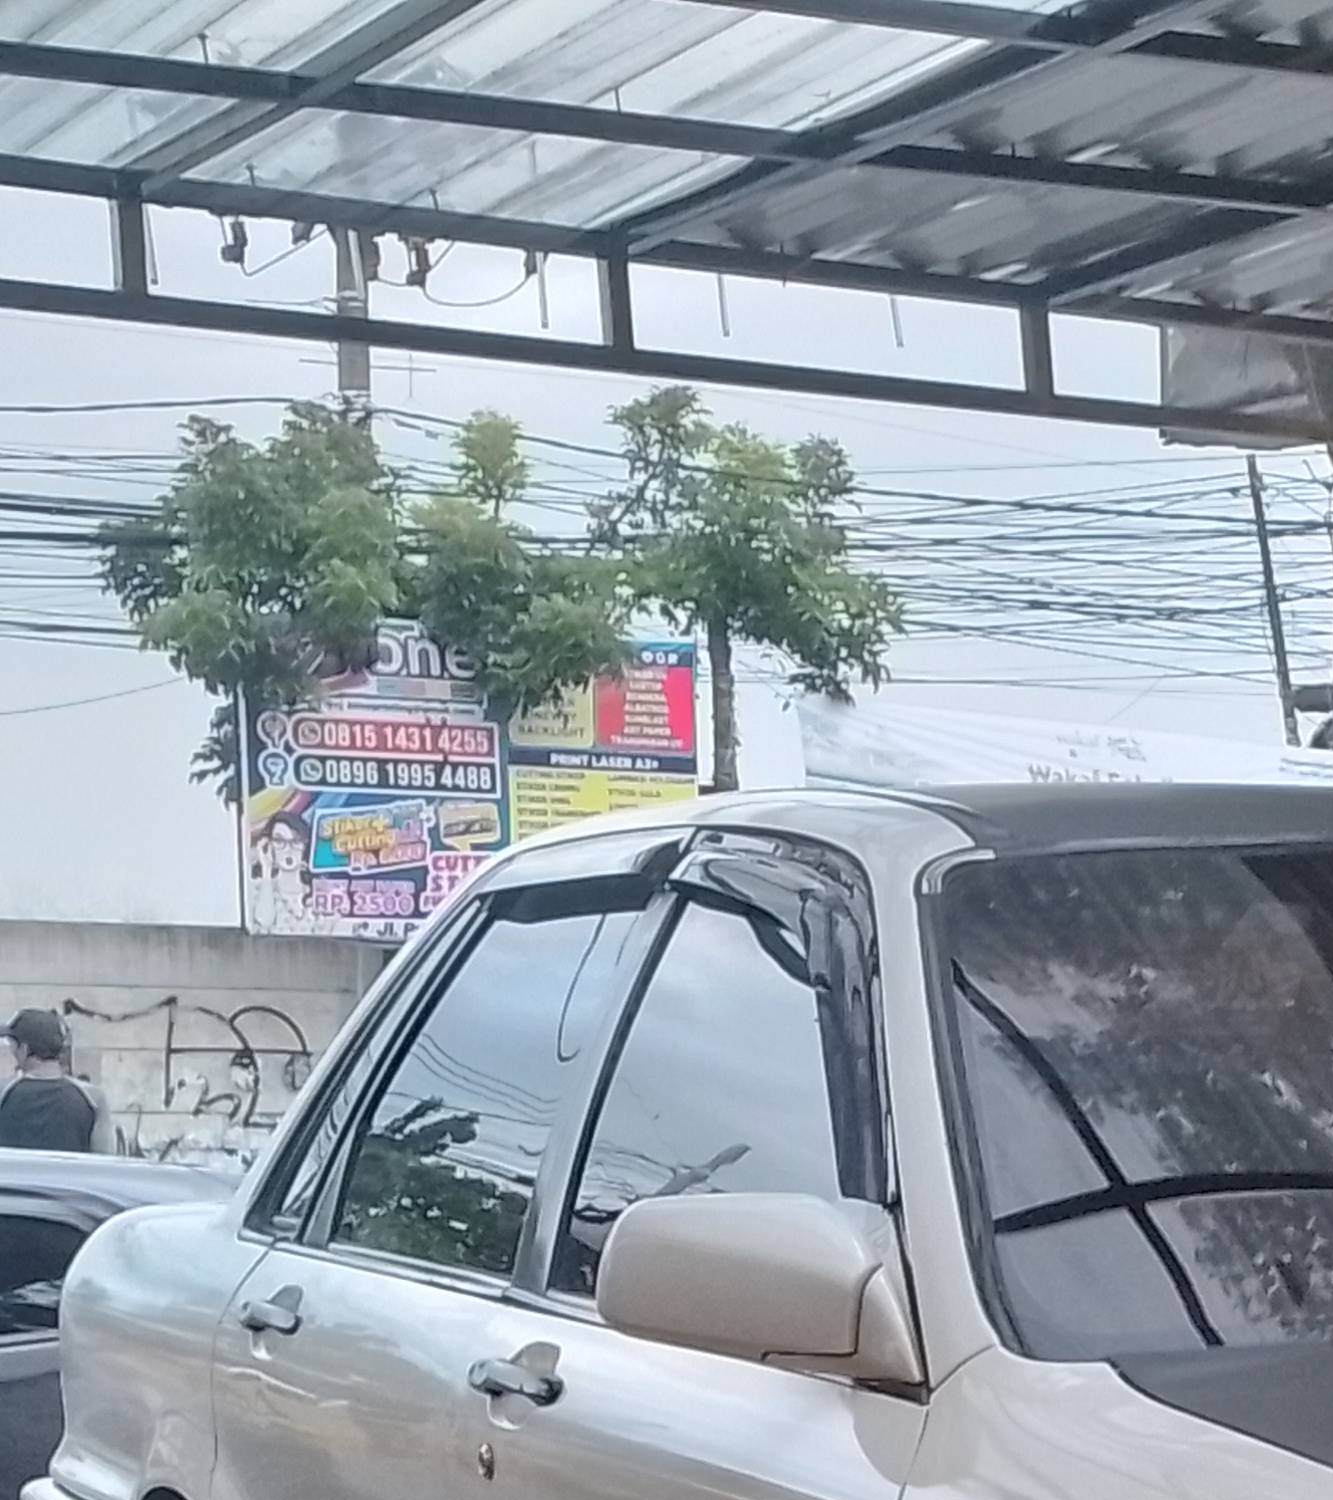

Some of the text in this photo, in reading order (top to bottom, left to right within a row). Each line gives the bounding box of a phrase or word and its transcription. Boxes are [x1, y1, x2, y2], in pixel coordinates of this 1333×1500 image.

[323, 721, 489, 754] 0815 1431 4255
[325, 760, 491, 790] 0896 1995 4488
[432, 855, 482, 872] CUTT
[354, 894, 413, 914] 2500
